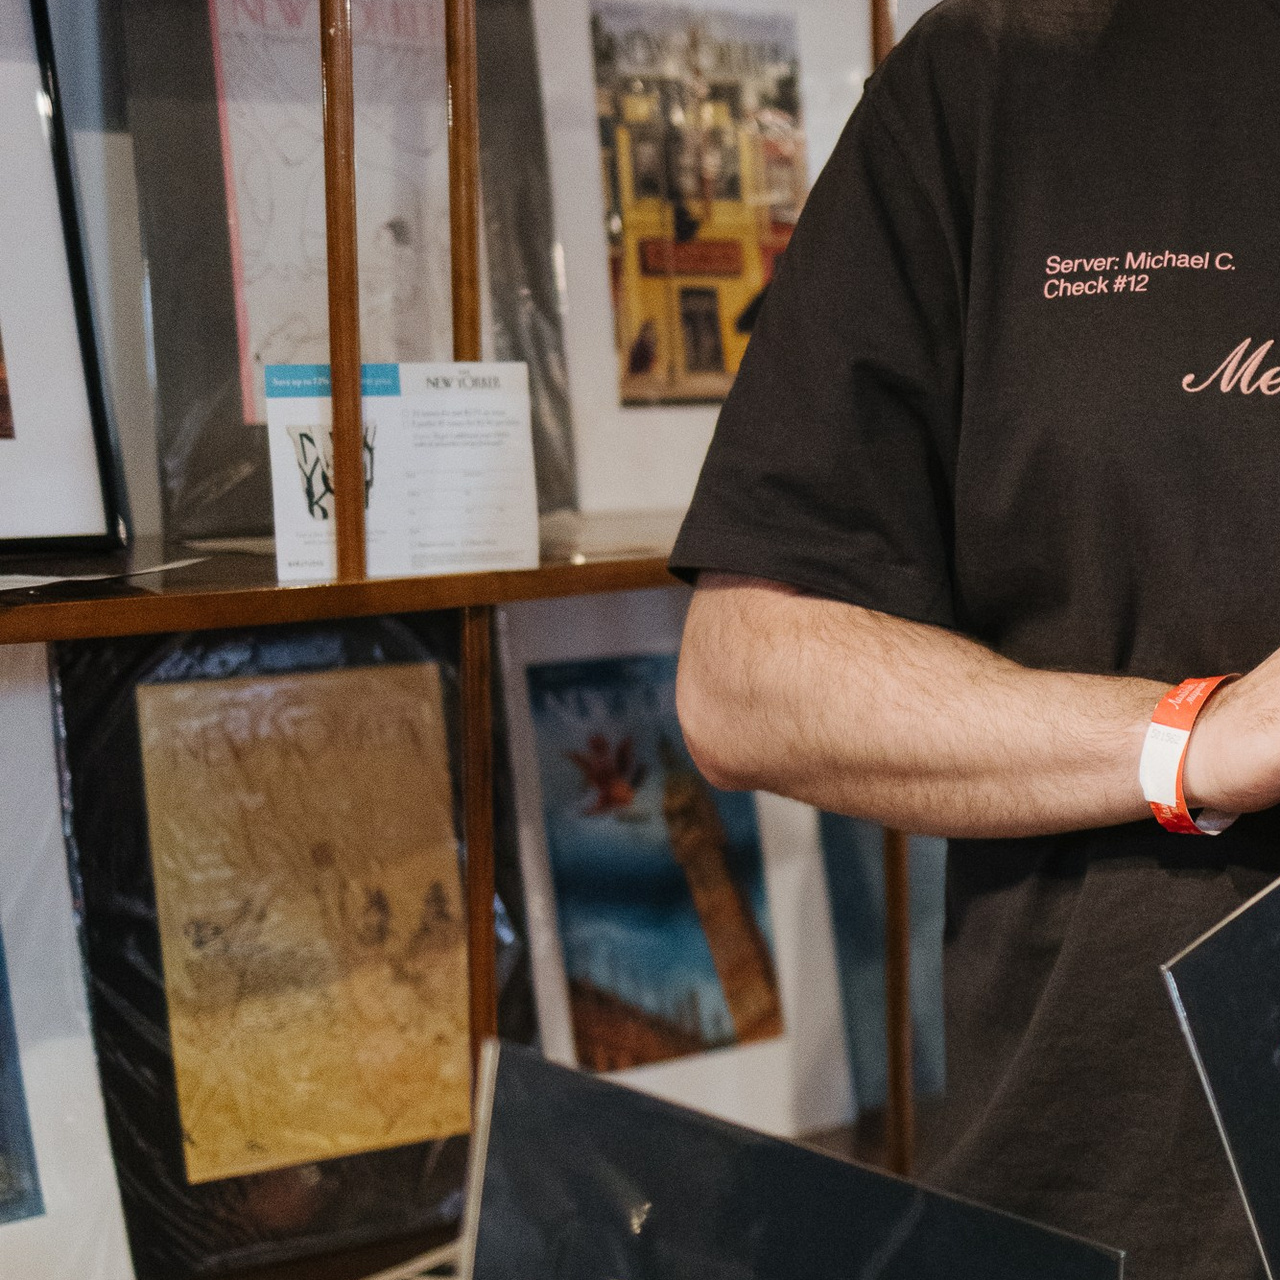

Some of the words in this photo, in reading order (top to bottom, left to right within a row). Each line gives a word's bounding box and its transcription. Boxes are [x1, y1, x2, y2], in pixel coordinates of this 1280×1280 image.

[1045, 254, 1120, 275] Server:
[1124, 249, 1210, 270] Michael
[1214, 252, 1237, 271] C.
[1043, 275, 1109, 300] Check
[1112, 273, 1150, 293] #12
[426, 376, 453, 390] NEW
